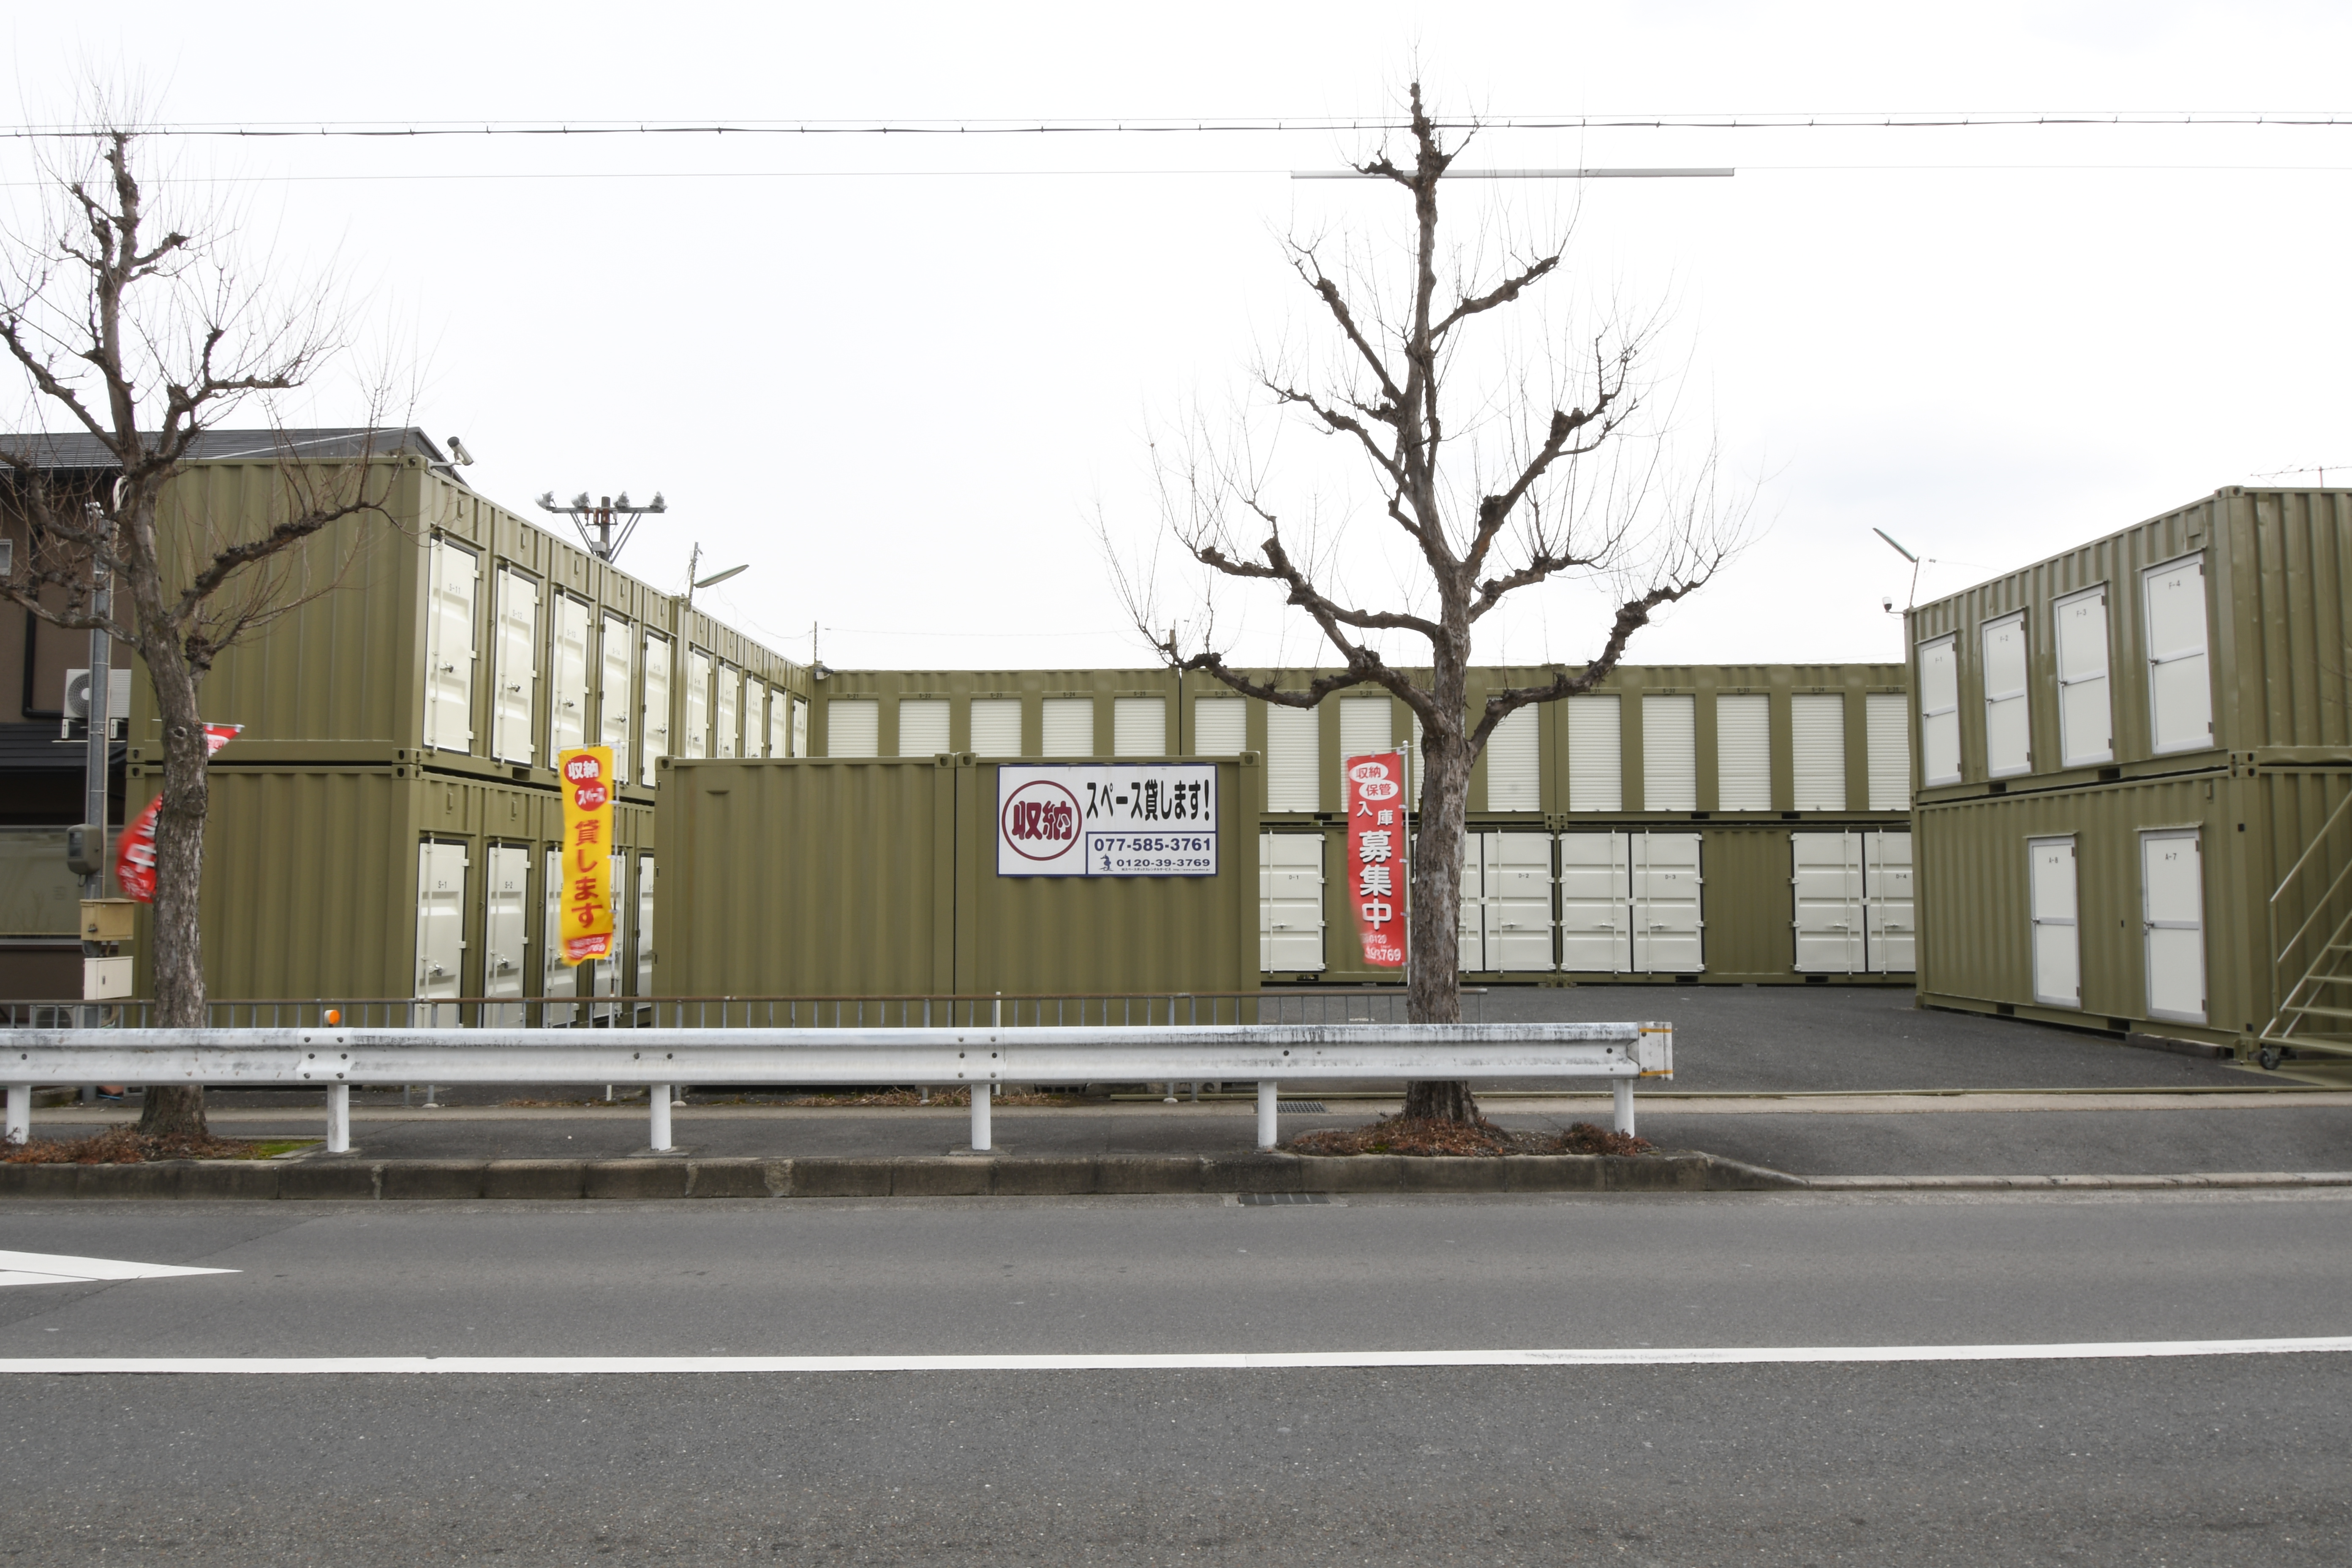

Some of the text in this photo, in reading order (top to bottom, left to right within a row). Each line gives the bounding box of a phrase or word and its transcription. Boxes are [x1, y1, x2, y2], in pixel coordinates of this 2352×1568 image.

[449, 583, 460, 594] S-11
[2169, 580, 2180, 590] F-4
[513, 609, 523, 620] S-12
[2076, 608, 2087, 617] F-3
[2000, 634, 2009, 642] F-2
[568, 760, 599, 779] 収納
[1356, 765, 1382, 779] 収納
[1366, 783, 1392, 797] 保管
[1086, 779, 1210, 821] スペース貸します!
[1012, 800, 1072, 840] 収納
[1094, 838, 1210, 852] 077-585-3761
[1116, 859, 1210, 867] 0120-39-3769
[571, 819, 604, 928] 貸します
[438, 880, 447, 889] S-1
